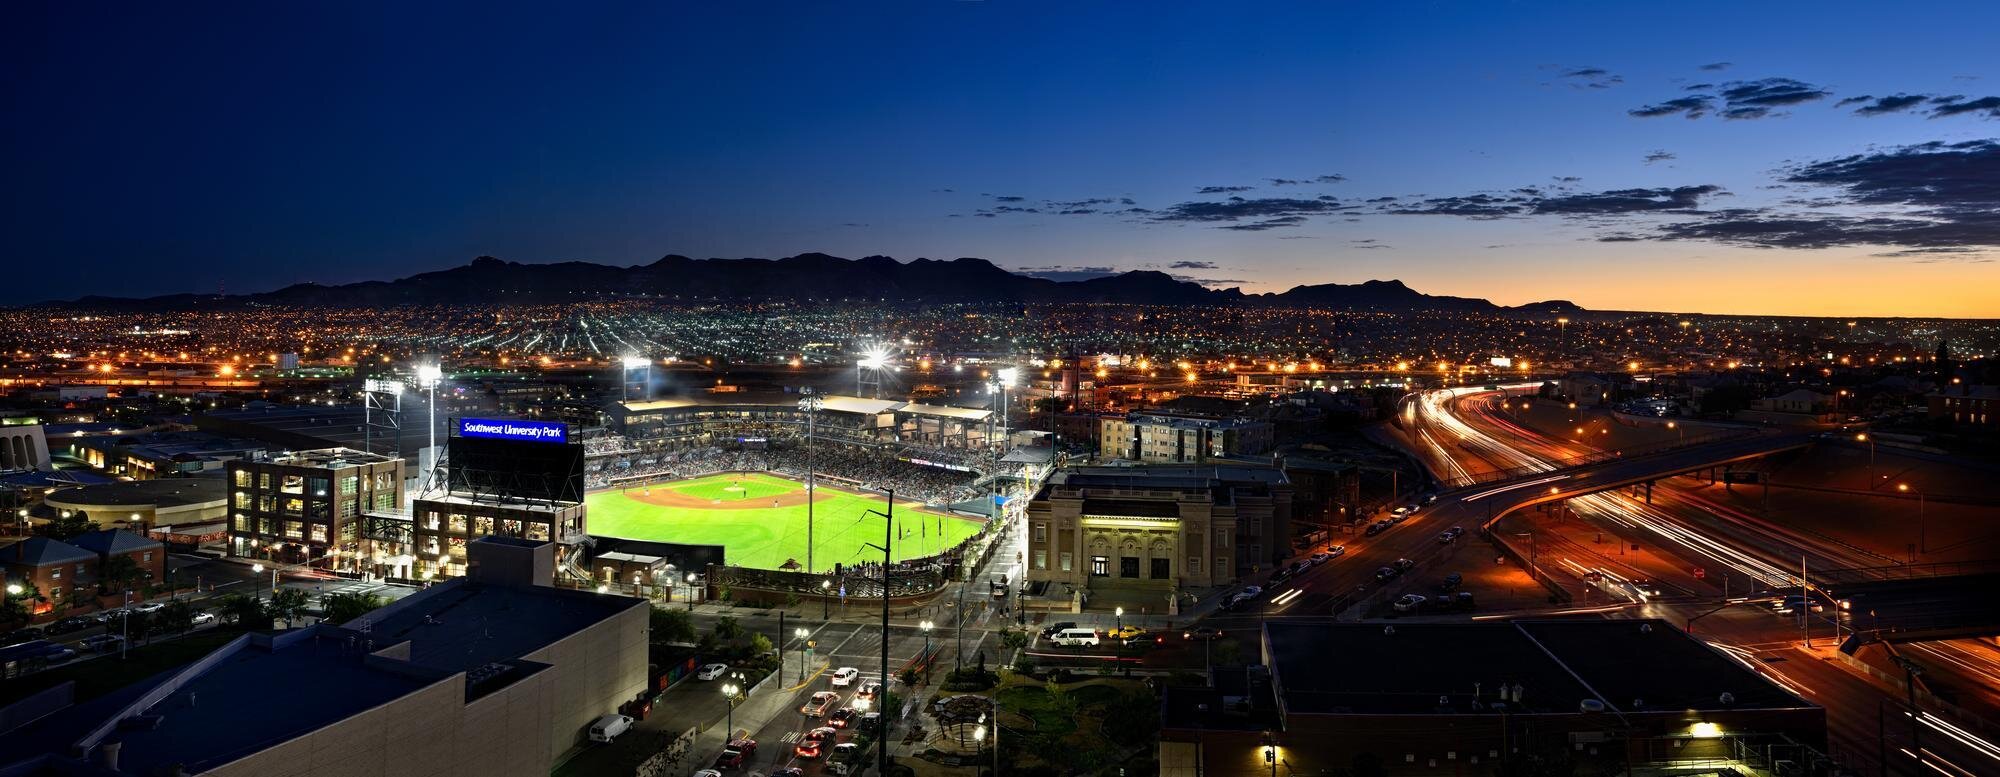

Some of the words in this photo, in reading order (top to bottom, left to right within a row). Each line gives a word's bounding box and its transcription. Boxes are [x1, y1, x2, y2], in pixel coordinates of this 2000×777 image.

[464, 422, 502, 434] Southwest
[504, 424, 541, 438] University
[543, 426, 561, 437] Park
